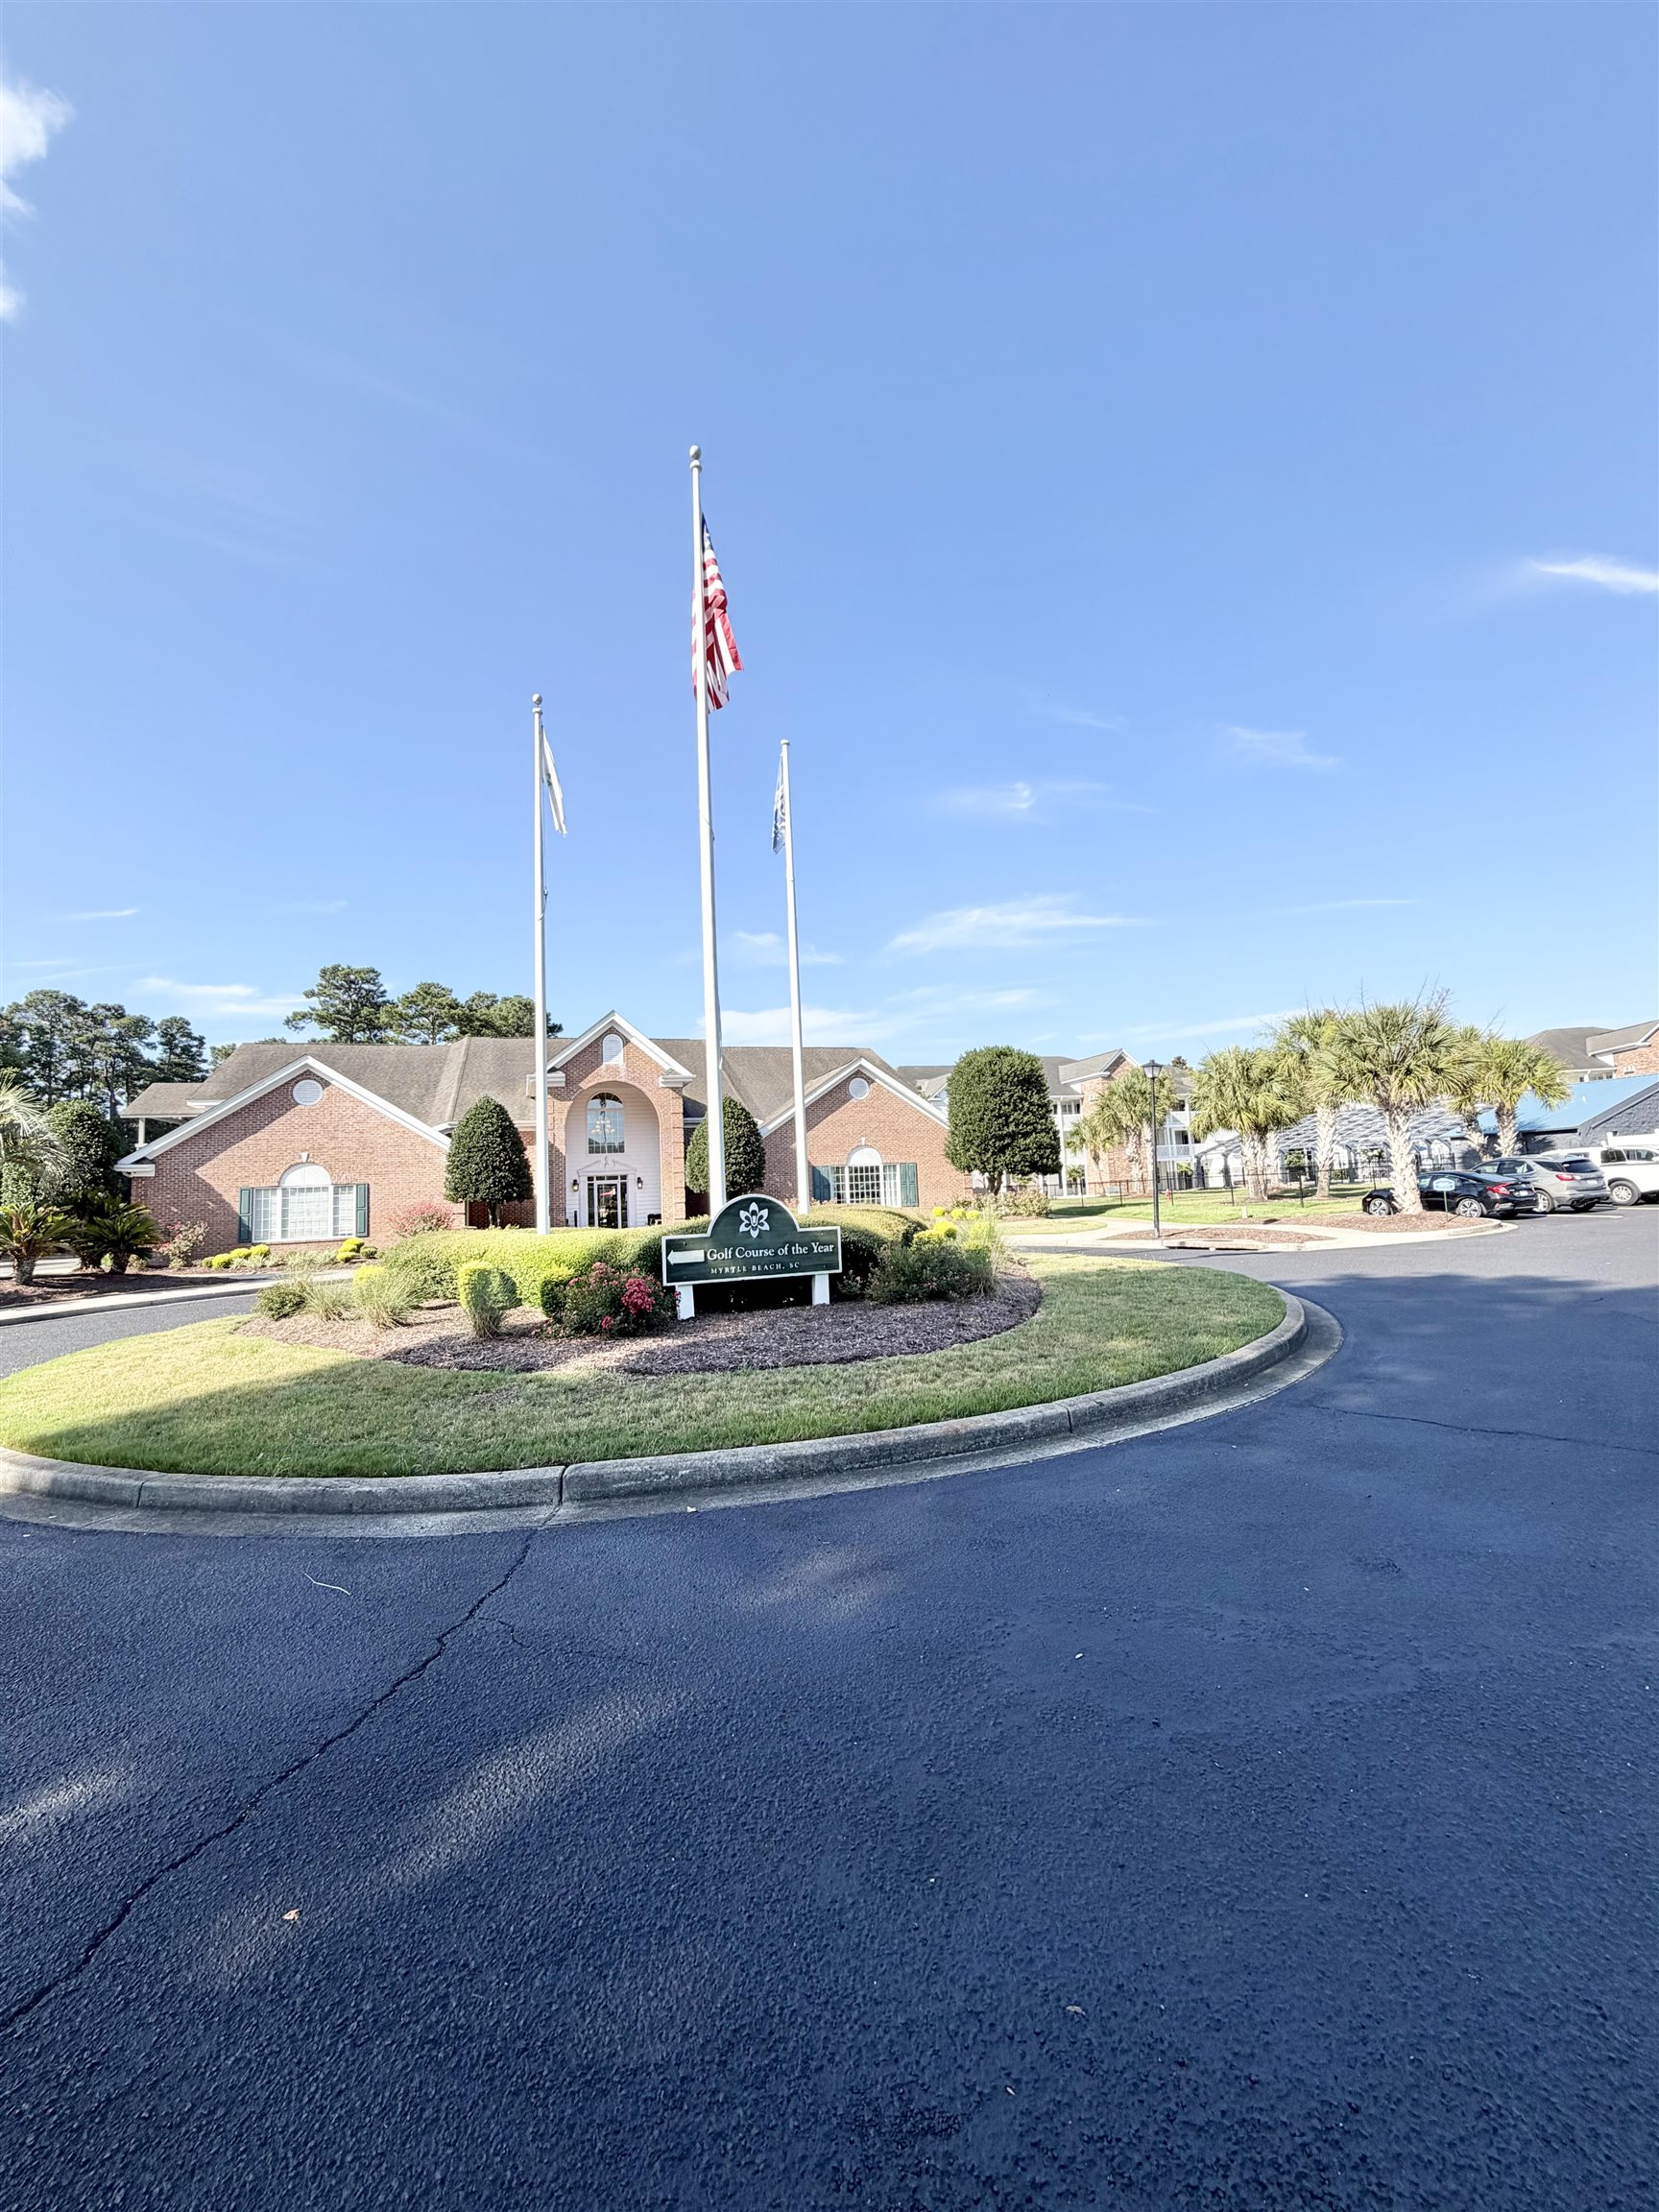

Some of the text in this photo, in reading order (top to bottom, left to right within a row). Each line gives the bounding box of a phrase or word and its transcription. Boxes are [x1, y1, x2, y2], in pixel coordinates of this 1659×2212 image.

[707, 1241, 834, 1261] Golf Course of the Year
[710, 1265, 747, 1274] MYRTLE
